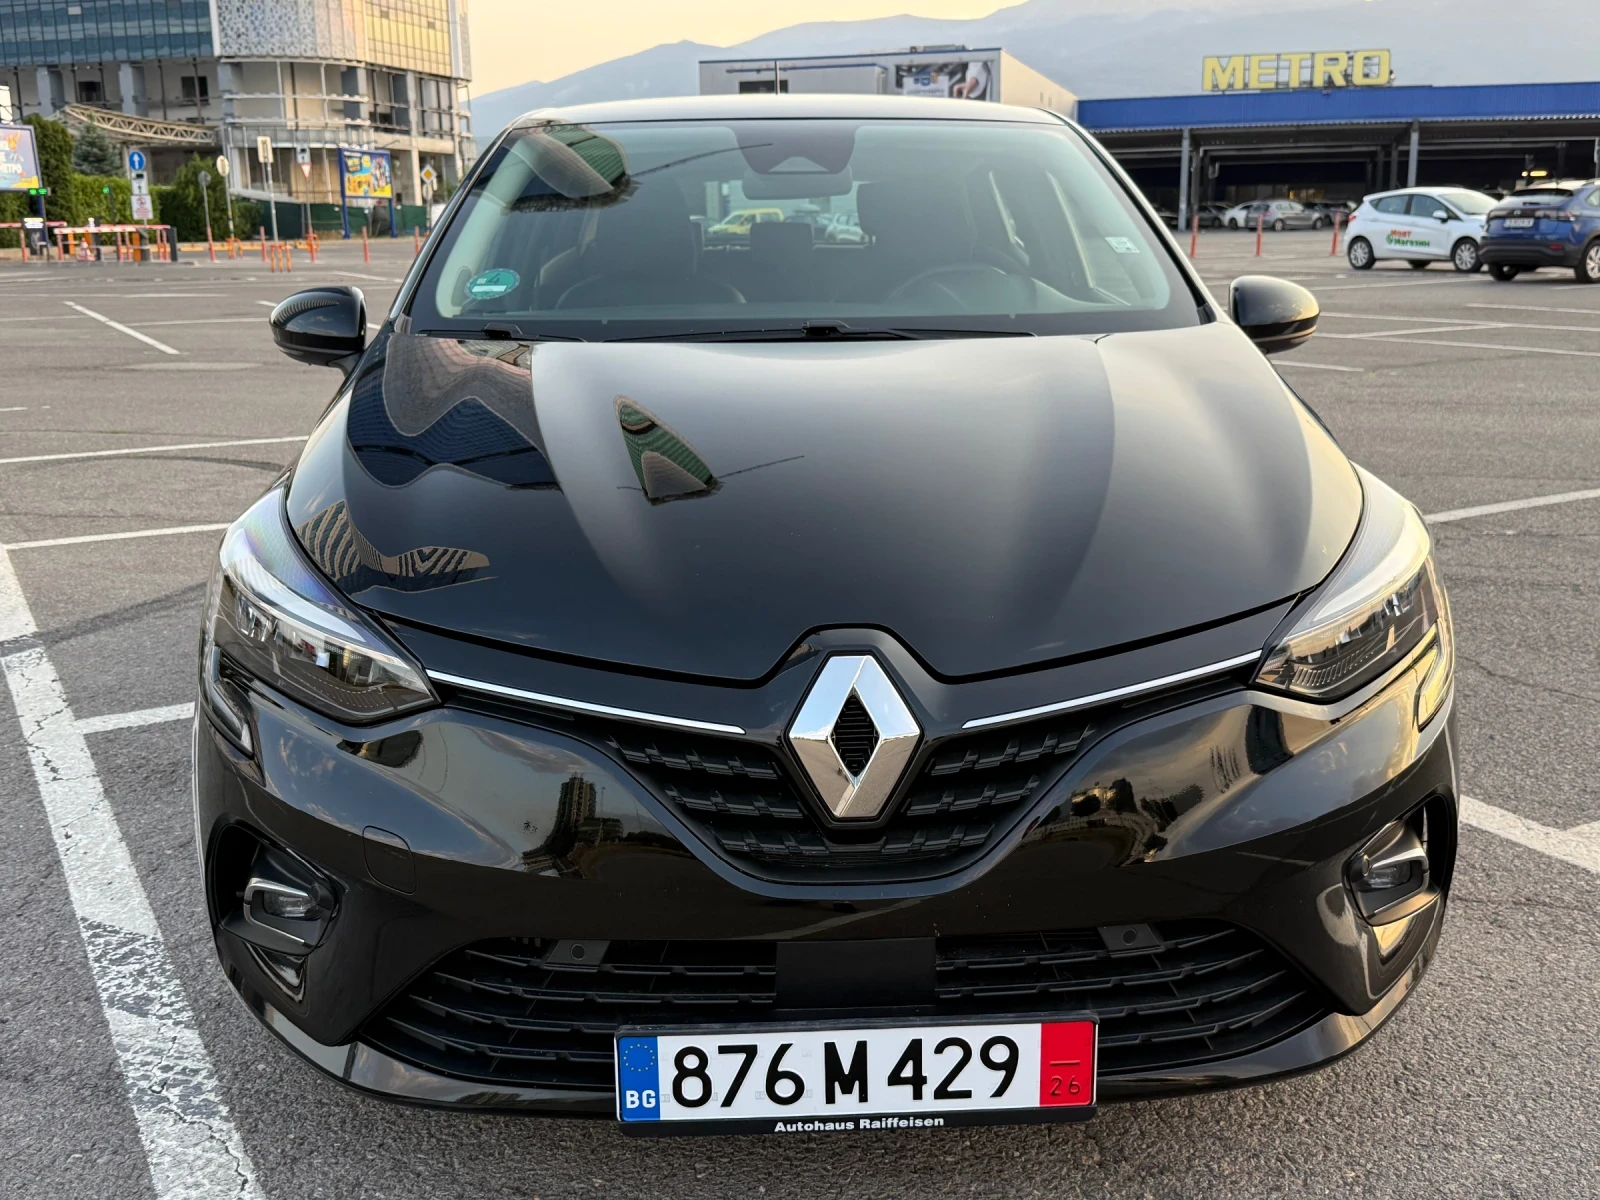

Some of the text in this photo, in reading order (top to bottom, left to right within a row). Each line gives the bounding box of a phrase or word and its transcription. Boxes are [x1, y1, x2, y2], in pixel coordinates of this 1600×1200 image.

[1202, 50, 1390, 91] METRO
[488, 272, 501, 285] 4
[672, 1035, 1019, 1108] 876 M 429
[1050, 1075, 1081, 1097] 26
[625, 1090, 656, 1109] BG
[774, 1117, 944, 1132] Autohaus Raiffeisen
